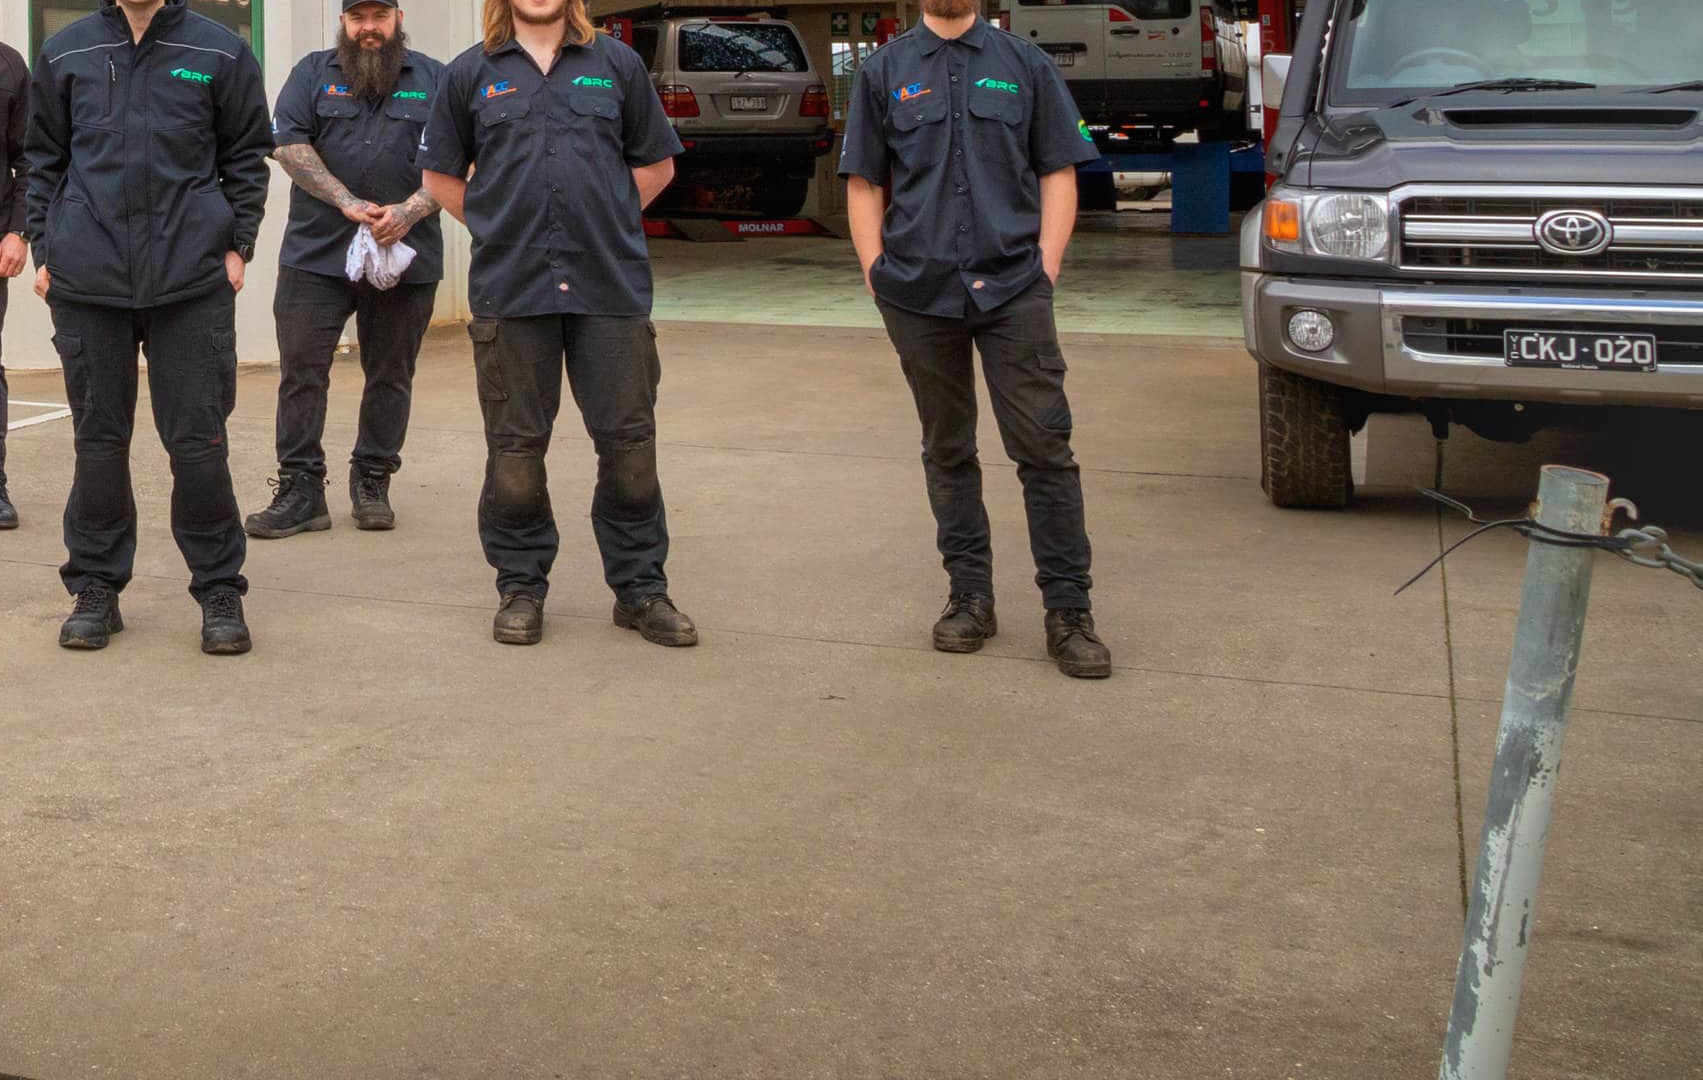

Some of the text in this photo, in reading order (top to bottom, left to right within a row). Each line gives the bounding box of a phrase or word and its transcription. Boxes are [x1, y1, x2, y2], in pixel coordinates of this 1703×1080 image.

[181, 70, 214, 86] BRC
[582, 77, 613, 89] BRC
[986, 79, 1019, 94] BRC
[400, 90, 427, 99] BRC
[738, 223, 784, 232] MOLNAR
[1510, 335, 1520, 359] VIC
